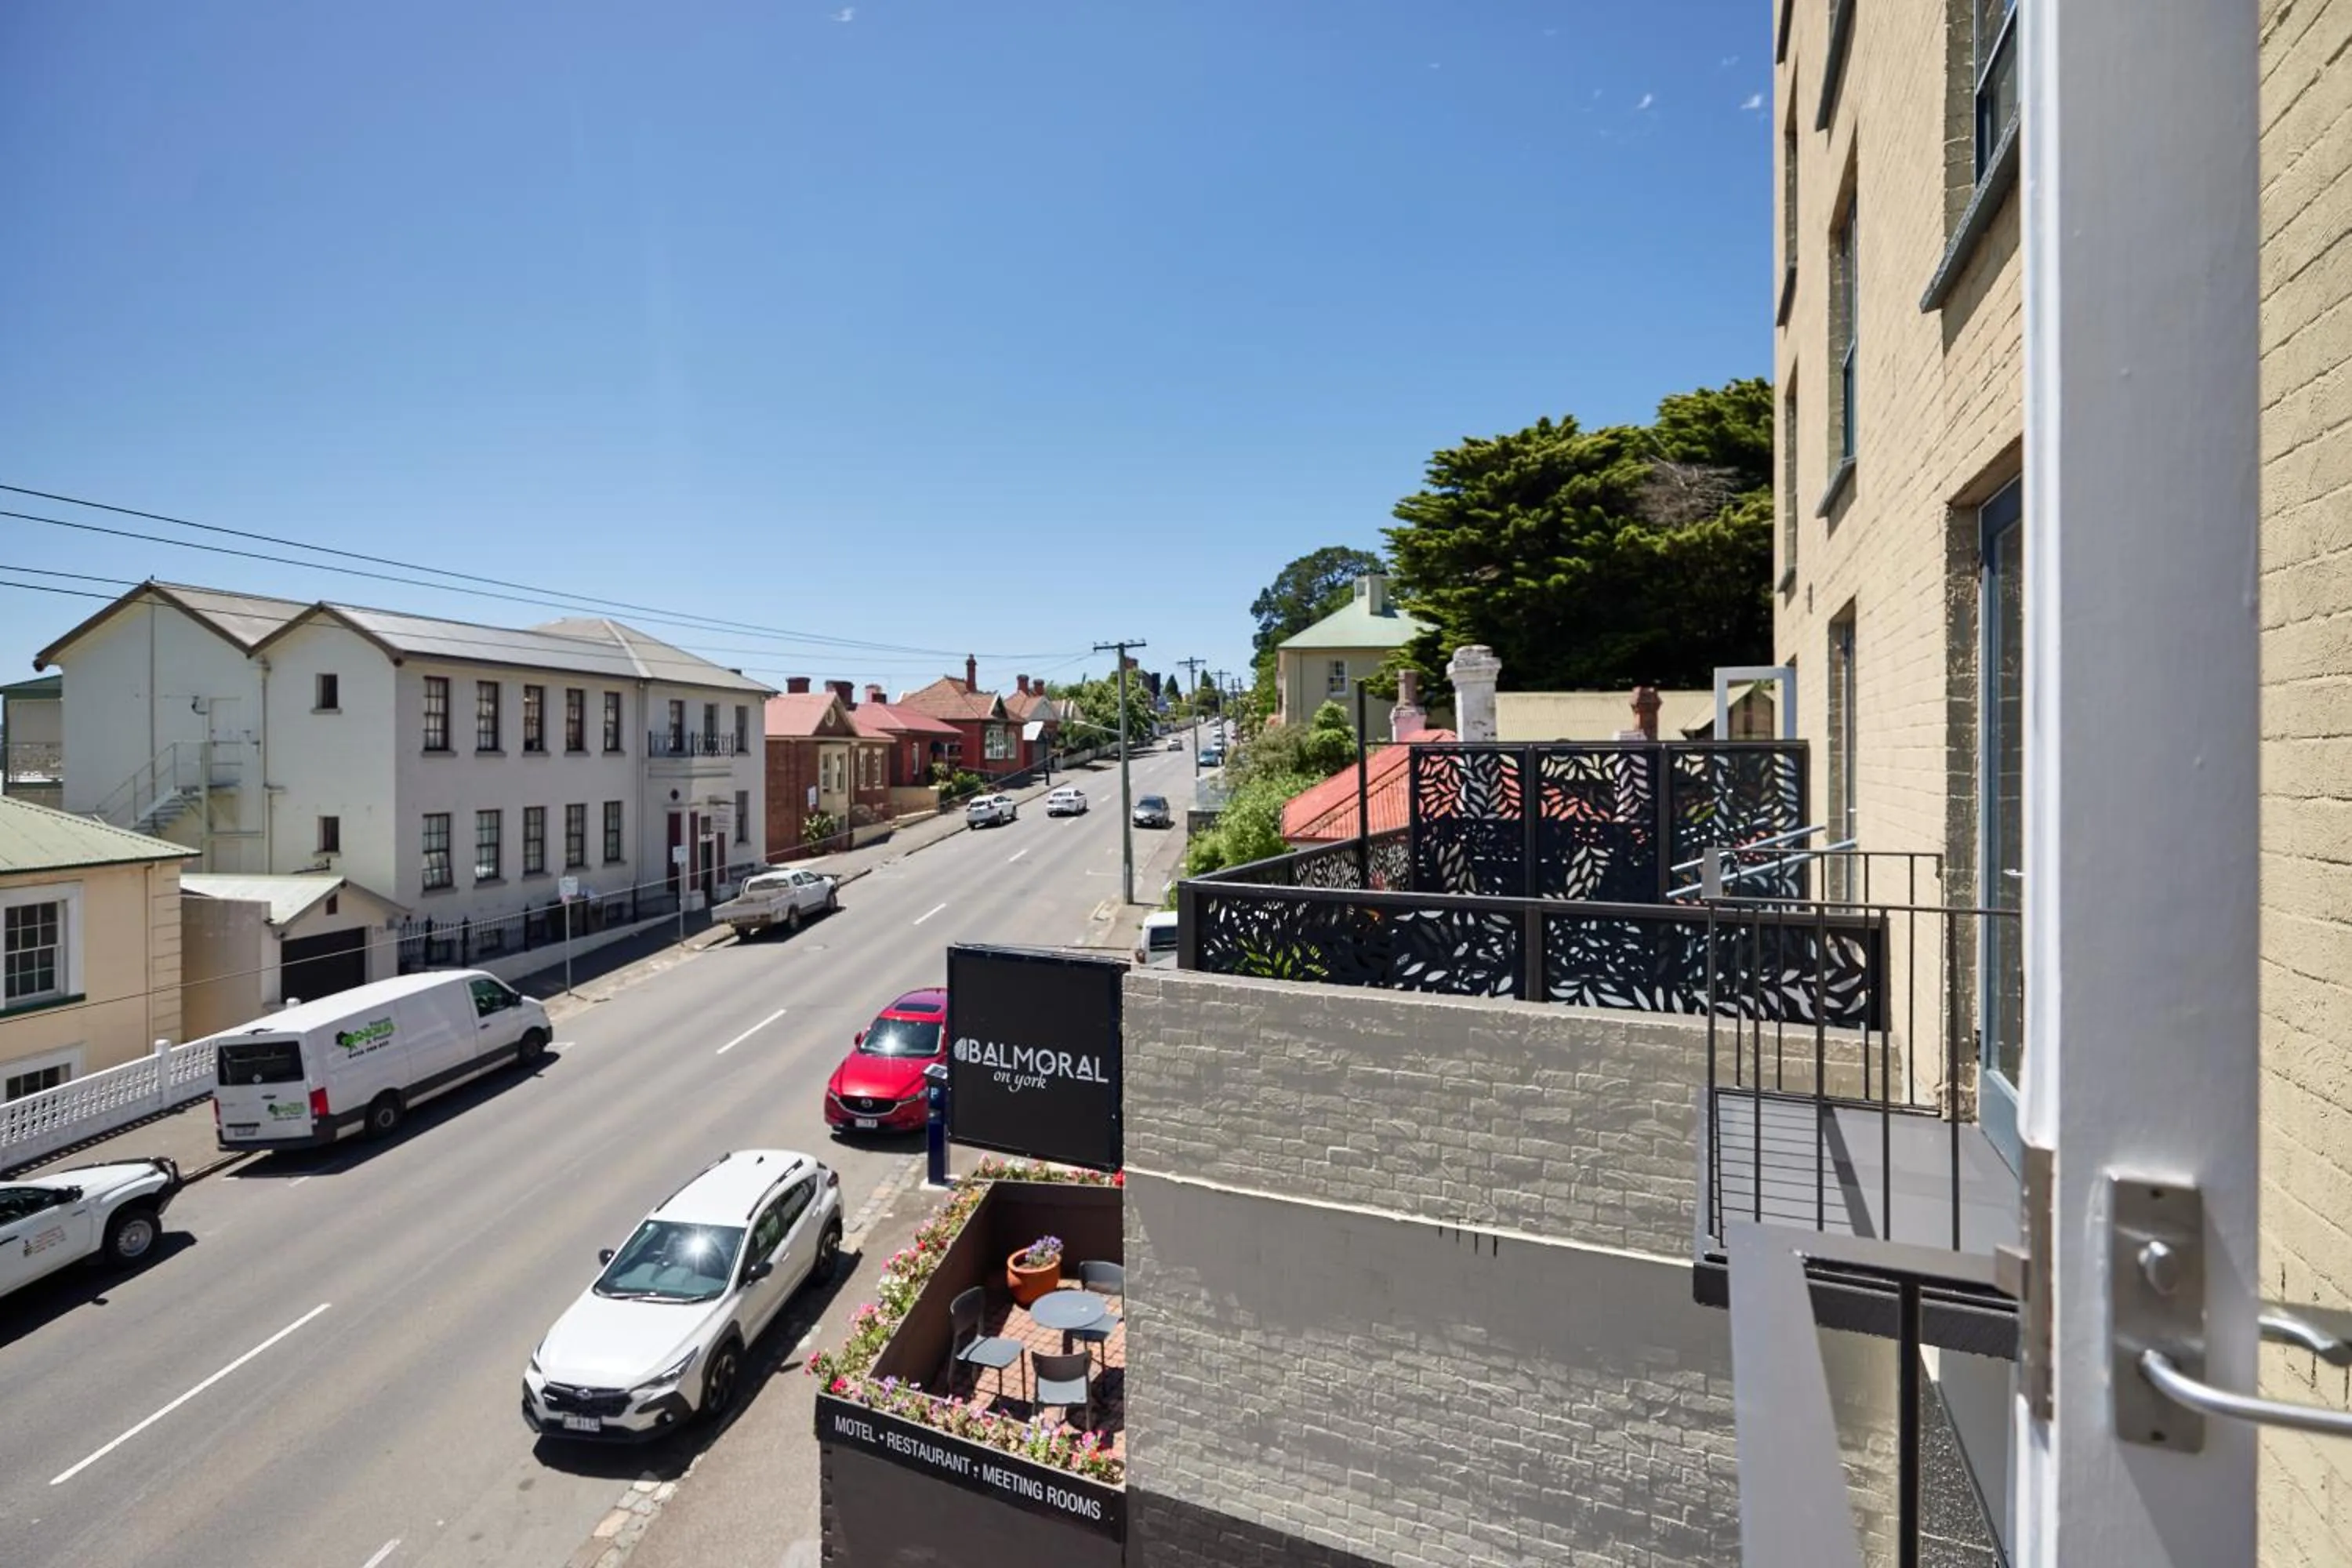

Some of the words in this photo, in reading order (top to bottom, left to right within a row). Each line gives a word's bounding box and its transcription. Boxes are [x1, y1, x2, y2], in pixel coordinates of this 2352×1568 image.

[967, 1038, 1109, 1083] BALMORAL
[993, 1069, 1011, 1083] on
[1007, 1072, 1047, 1093] york
[834, 1414, 877, 1444] MOTEL
[886, 1431, 971, 1475] RESTAURANT
[982, 1463, 1044, 1501] MEETING
[1047, 1486, 1102, 1520] ROOMS
